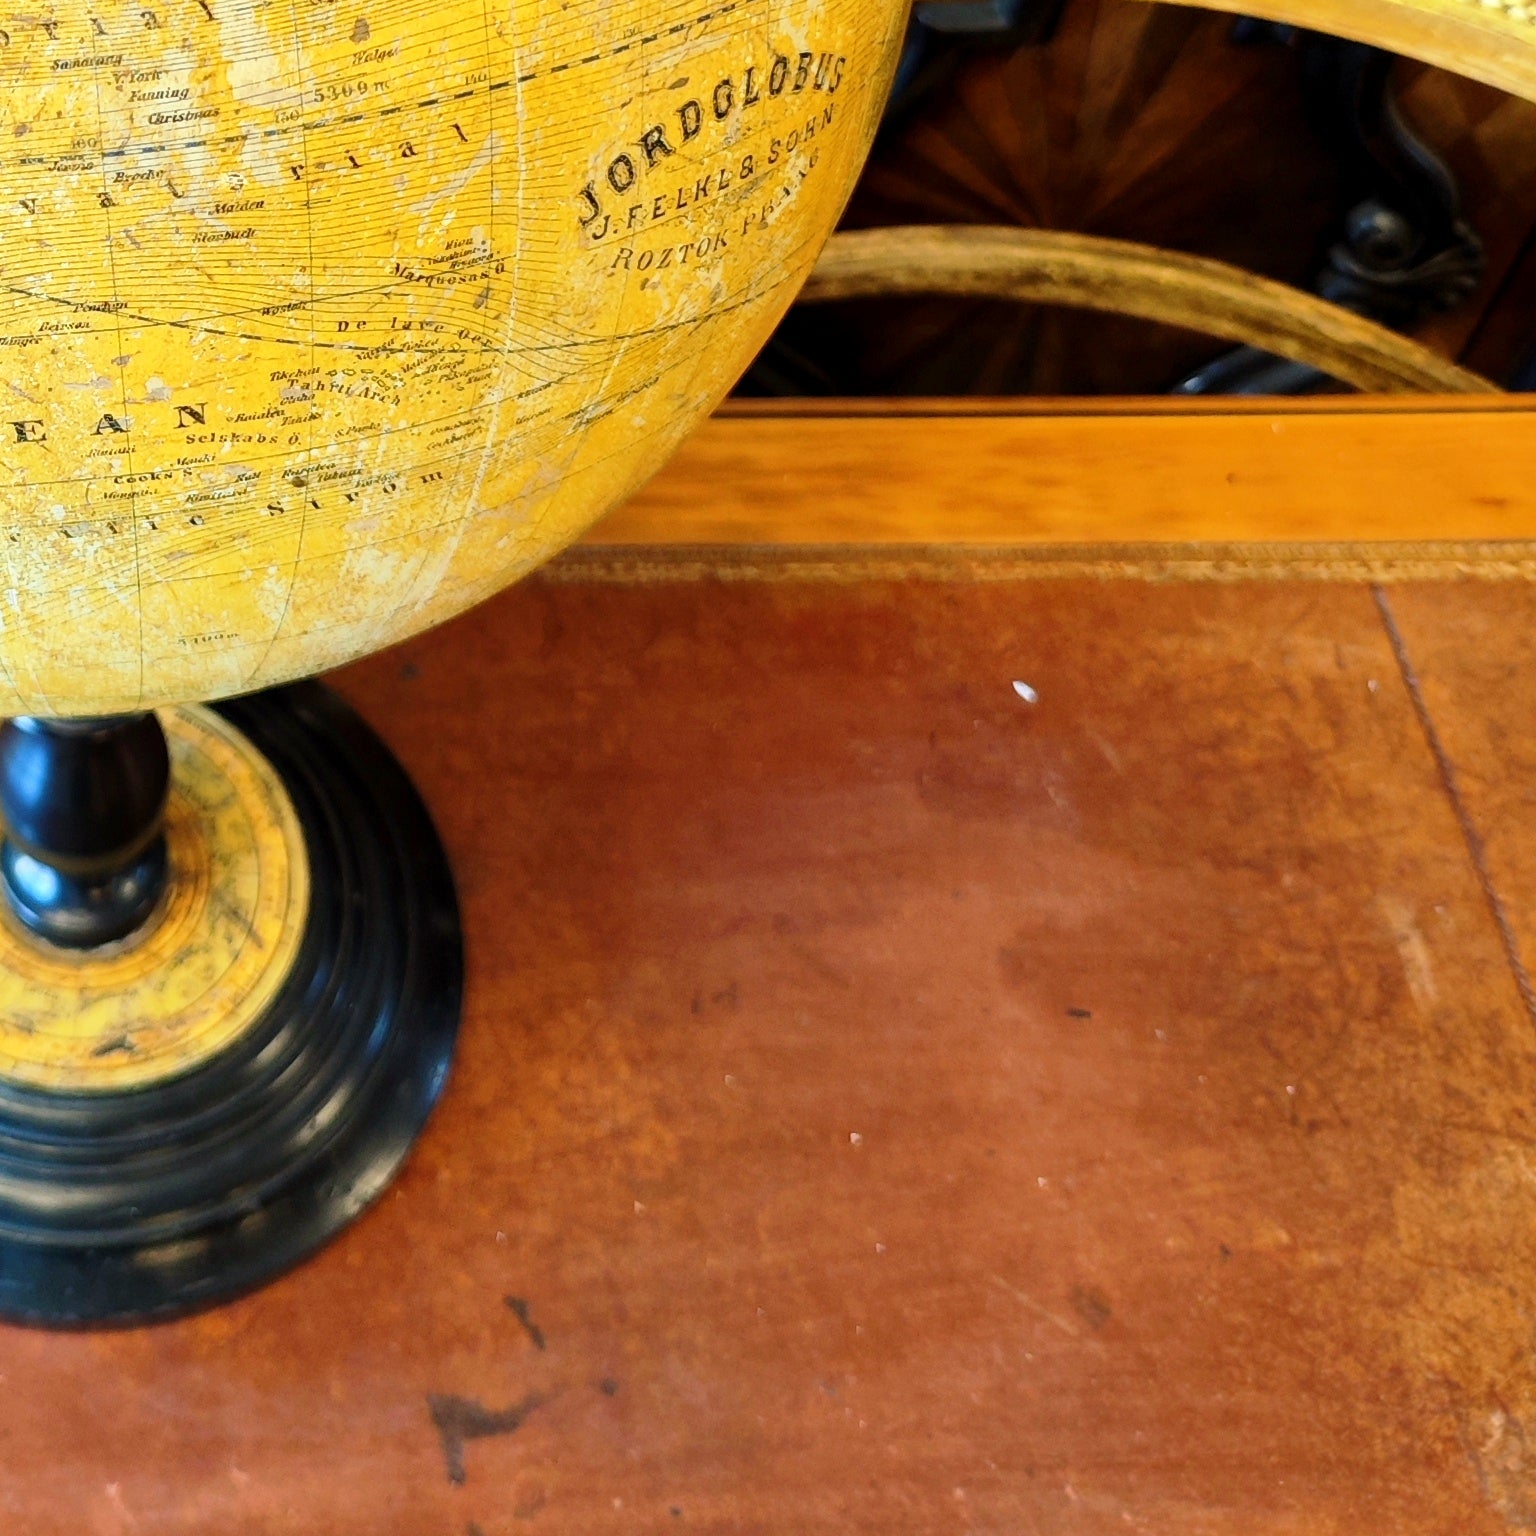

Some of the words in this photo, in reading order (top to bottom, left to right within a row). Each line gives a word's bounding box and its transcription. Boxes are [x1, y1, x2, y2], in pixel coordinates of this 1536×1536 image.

[127, 88, 190, 104] Fanning
[147, 107, 221, 126] Christmas
[575, 51, 847, 228] JORDGLOBUS
[592, 214, 619, 241] J.
[625, 168, 731, 229] FELKL
[738, 153, 756, 180] &
[767, 101, 836, 165] SOHN
[270, 366, 321, 382] Tikehau
[356, 384, 402, 407] Arch
[185, 430, 278, 447] Selskabs
[113, 470, 174, 485] Cooks
